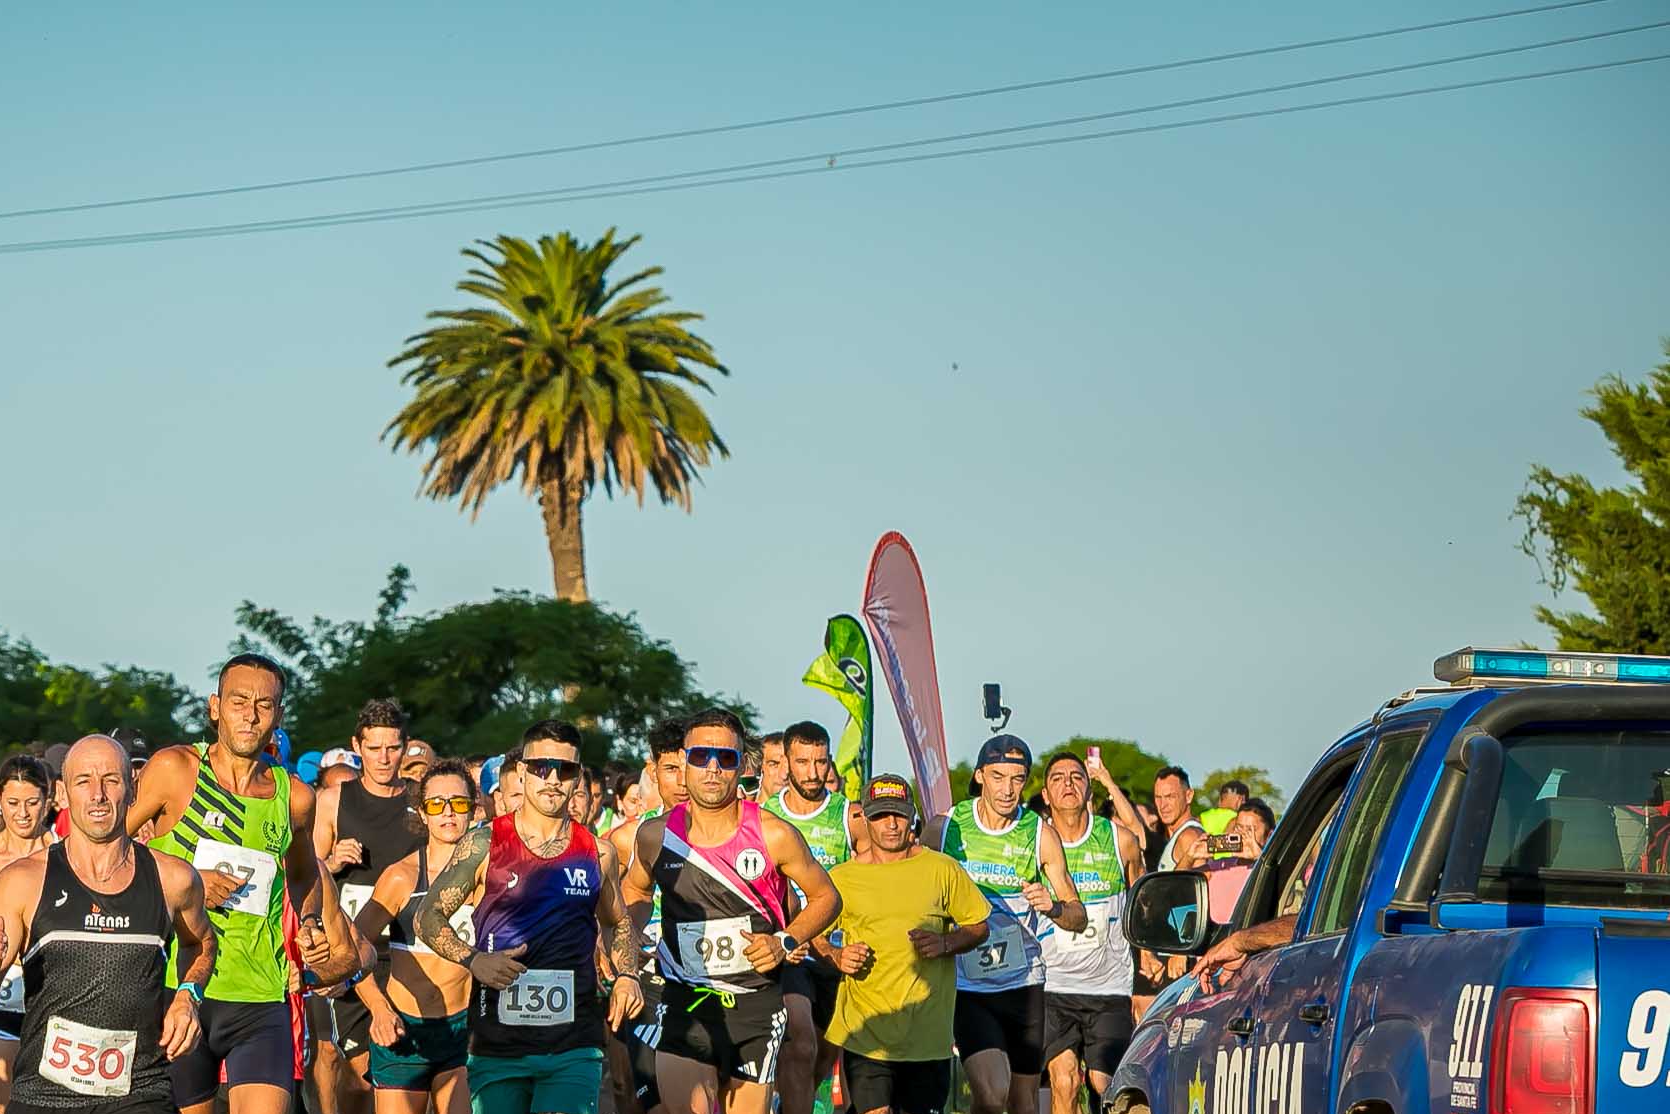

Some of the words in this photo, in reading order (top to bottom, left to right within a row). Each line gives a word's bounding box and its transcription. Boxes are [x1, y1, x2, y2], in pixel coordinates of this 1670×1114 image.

[563, 868, 589, 888] VR
[563, 887, 590, 897] TEAM
[84, 912, 130, 928] ATENAS
[695, 936, 735, 963] 98
[976, 942, 1009, 967] 37
[506, 986, 568, 1013] 130
[1448, 984, 1494, 1078] 911
[1619, 990, 1670, 1087] 9
[48, 1036, 125, 1080] 530
